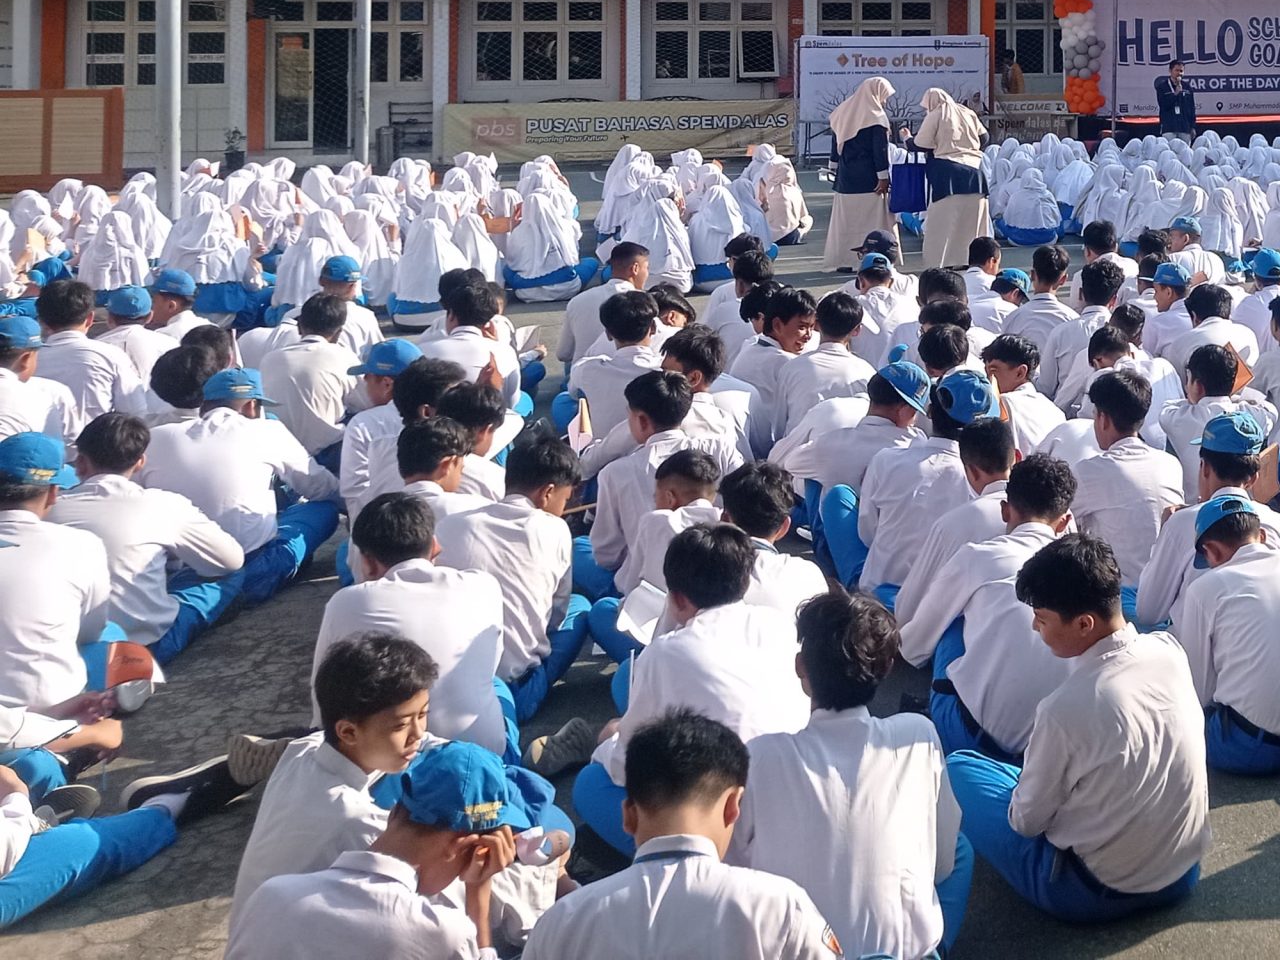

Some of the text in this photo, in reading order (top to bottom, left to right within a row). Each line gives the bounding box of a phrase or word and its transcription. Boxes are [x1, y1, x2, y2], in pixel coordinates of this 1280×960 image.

[1117, 18, 1244, 65] HELLO
[852, 53, 955, 71] Tree of Hope
[1208, 78, 1227, 90] OF
[1230, 78, 1253, 90] THE
[1255, 77, 1280, 89] DAY
[996, 102, 1051, 111] WELCOME
[525, 113, 789, 134] PUSAT BAHASA SPEMDALAS
[525, 134, 609, 144] Preparing Your Future
